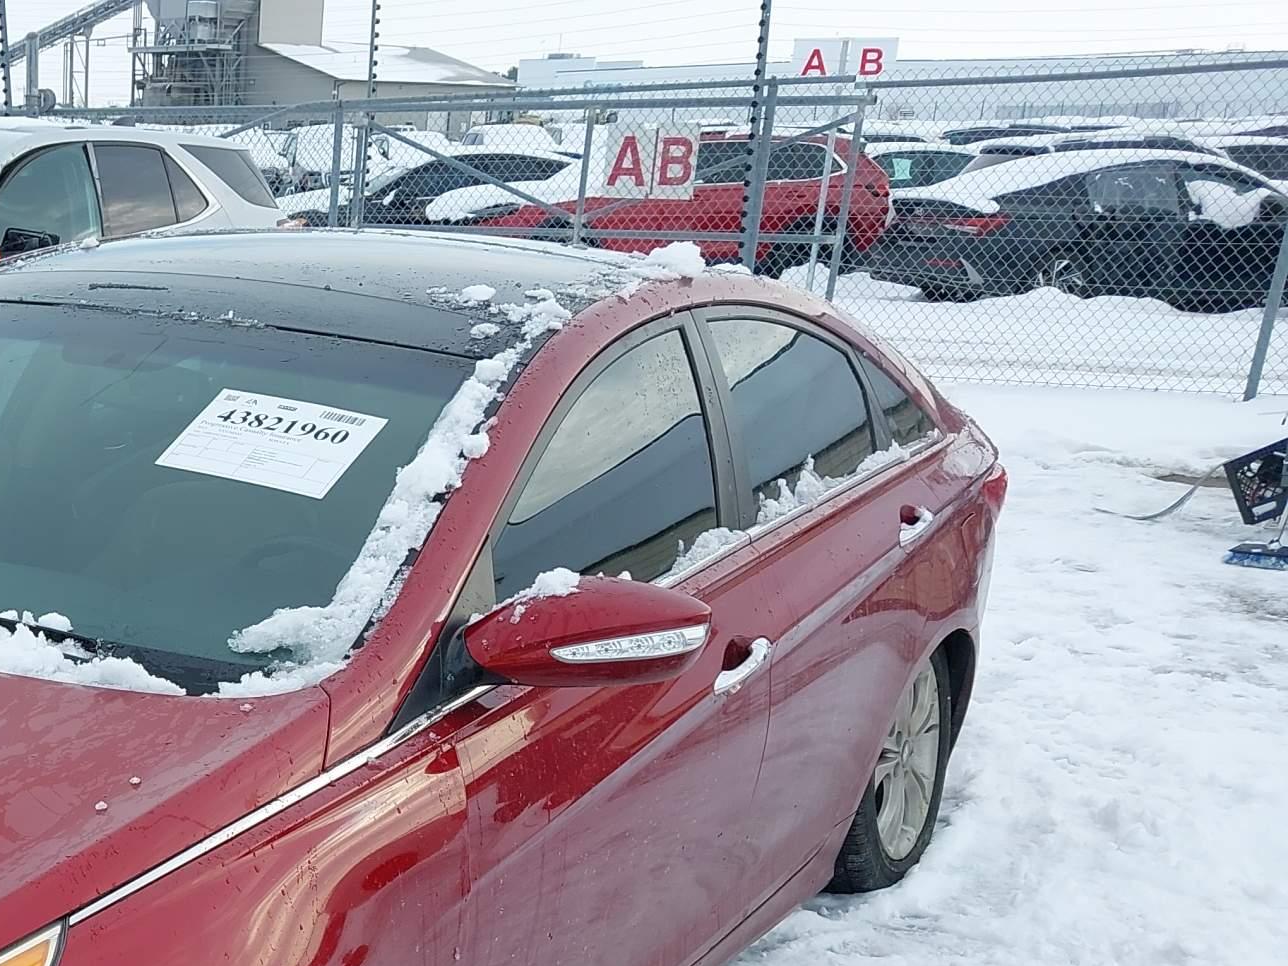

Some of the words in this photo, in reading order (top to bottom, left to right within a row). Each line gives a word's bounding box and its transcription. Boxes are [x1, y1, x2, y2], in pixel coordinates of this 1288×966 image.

[801, 47, 827, 76] A
[858, 47, 884, 76] B
[606, 134, 645, 187] A
[657, 135, 694, 186] B
[216, 408, 350, 445] 43821960
